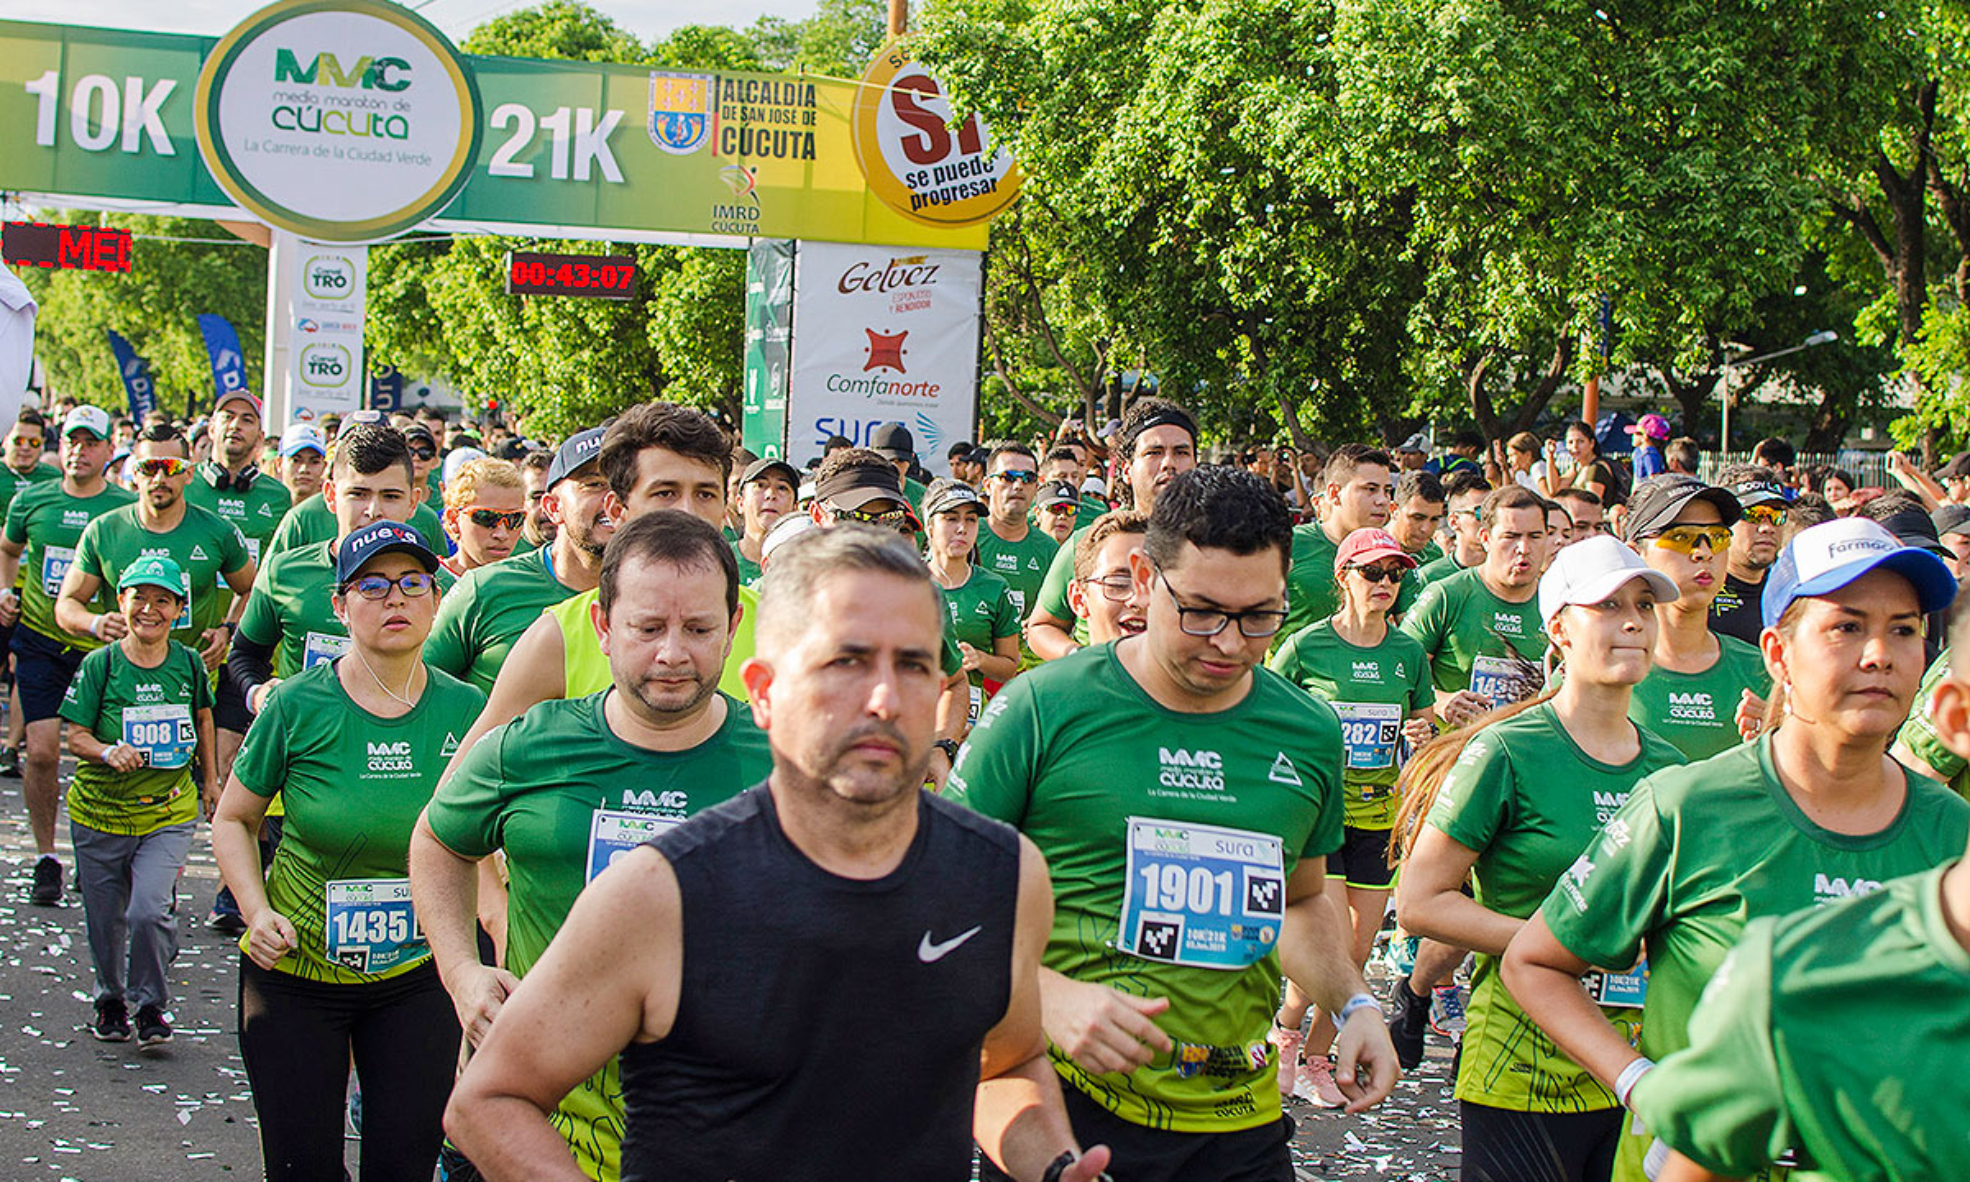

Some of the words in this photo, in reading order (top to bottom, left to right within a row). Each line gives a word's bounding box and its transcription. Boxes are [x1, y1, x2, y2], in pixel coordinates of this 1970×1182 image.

[275, 48, 411, 92] MMC
[393, 98, 411, 112] de
[723, 78, 817, 108] ALCALDÍA
[24, 70, 178, 156] 10K
[722, 105, 737, 120] DE
[740, 106, 765, 123] SAN
[768, 107, 797, 126] JOSÉ
[802, 111, 816, 126] DE
[244, 139, 260, 151] La
[262, 139, 310, 157] Carrera
[313, 144, 331, 158] de
[334, 146, 344, 159] la
[347, 147, 392, 163] Ciudad
[395, 151, 432, 167] Verde
[488, 103, 625, 183] 21K
[722, 122, 816, 160] CÚCUTA
[905, 172, 930, 190] se
[933, 156, 995, 187] puede
[910, 177, 997, 212] progresar
[713, 204, 760, 221] IMRD
[312, 274, 347, 288] TRO
[511, 261, 635, 290] 00:43:07
[308, 362, 343, 376] TRO
[827, 374, 940, 398] Comfanorte
[1669, 692, 1713, 705] MMC
[132, 723, 171, 745] 908
[367, 742, 411, 755] MMC
[1159, 747, 1222, 769] MMC
[623, 789, 687, 808] MMC
[619, 819, 654, 831] MMC
[1155, 829, 1190, 840] MMC
[1216, 840, 1254, 857] sura
[1141, 863, 1233, 916] 1901
[333, 911, 407, 943] 1435
